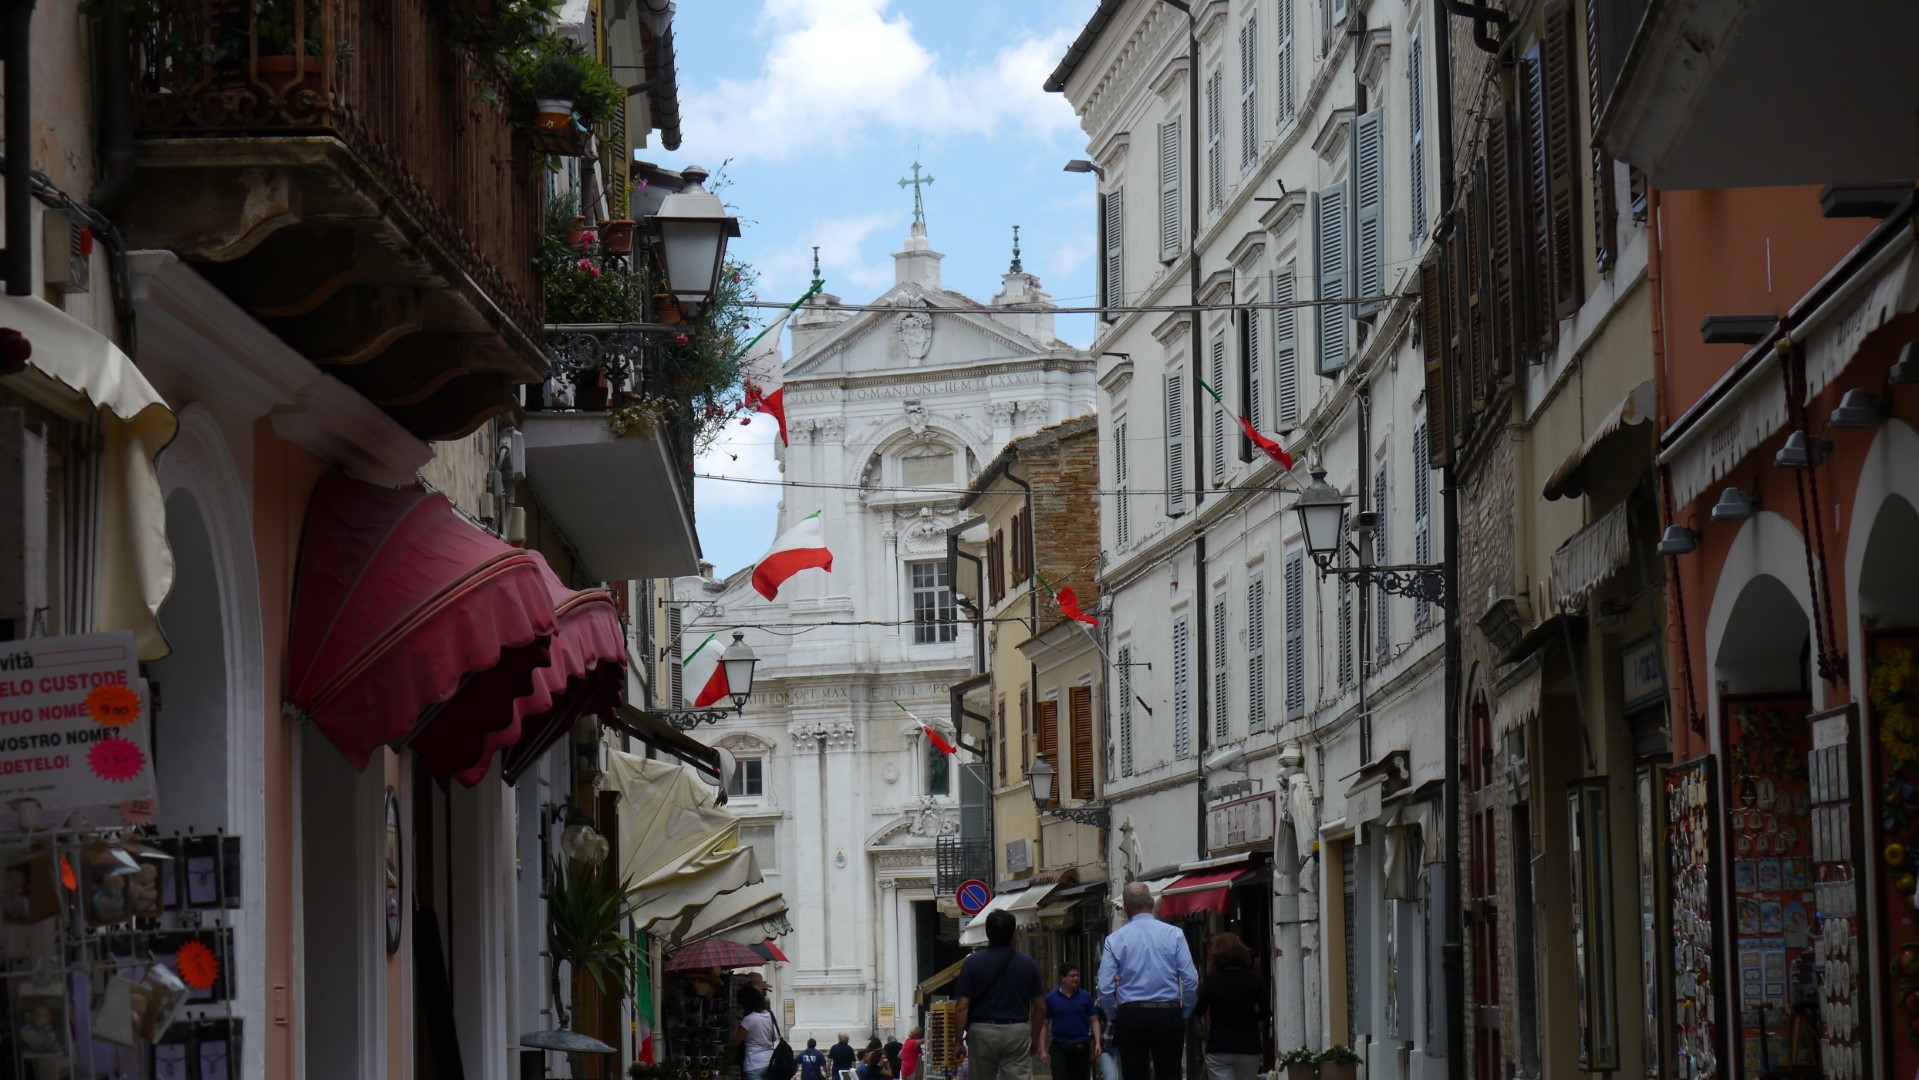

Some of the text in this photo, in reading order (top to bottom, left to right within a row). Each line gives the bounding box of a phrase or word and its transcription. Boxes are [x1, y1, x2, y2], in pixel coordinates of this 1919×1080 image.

[789, 392, 824, 404] SIXTO
[39, 669, 128, 692] CUSTODE
[795, 688, 816, 699] OPT
[821, 686, 847, 698] MAX
[0, 702, 91, 725] TUO NOME
[0, 732, 61, 751] VOSTRO
